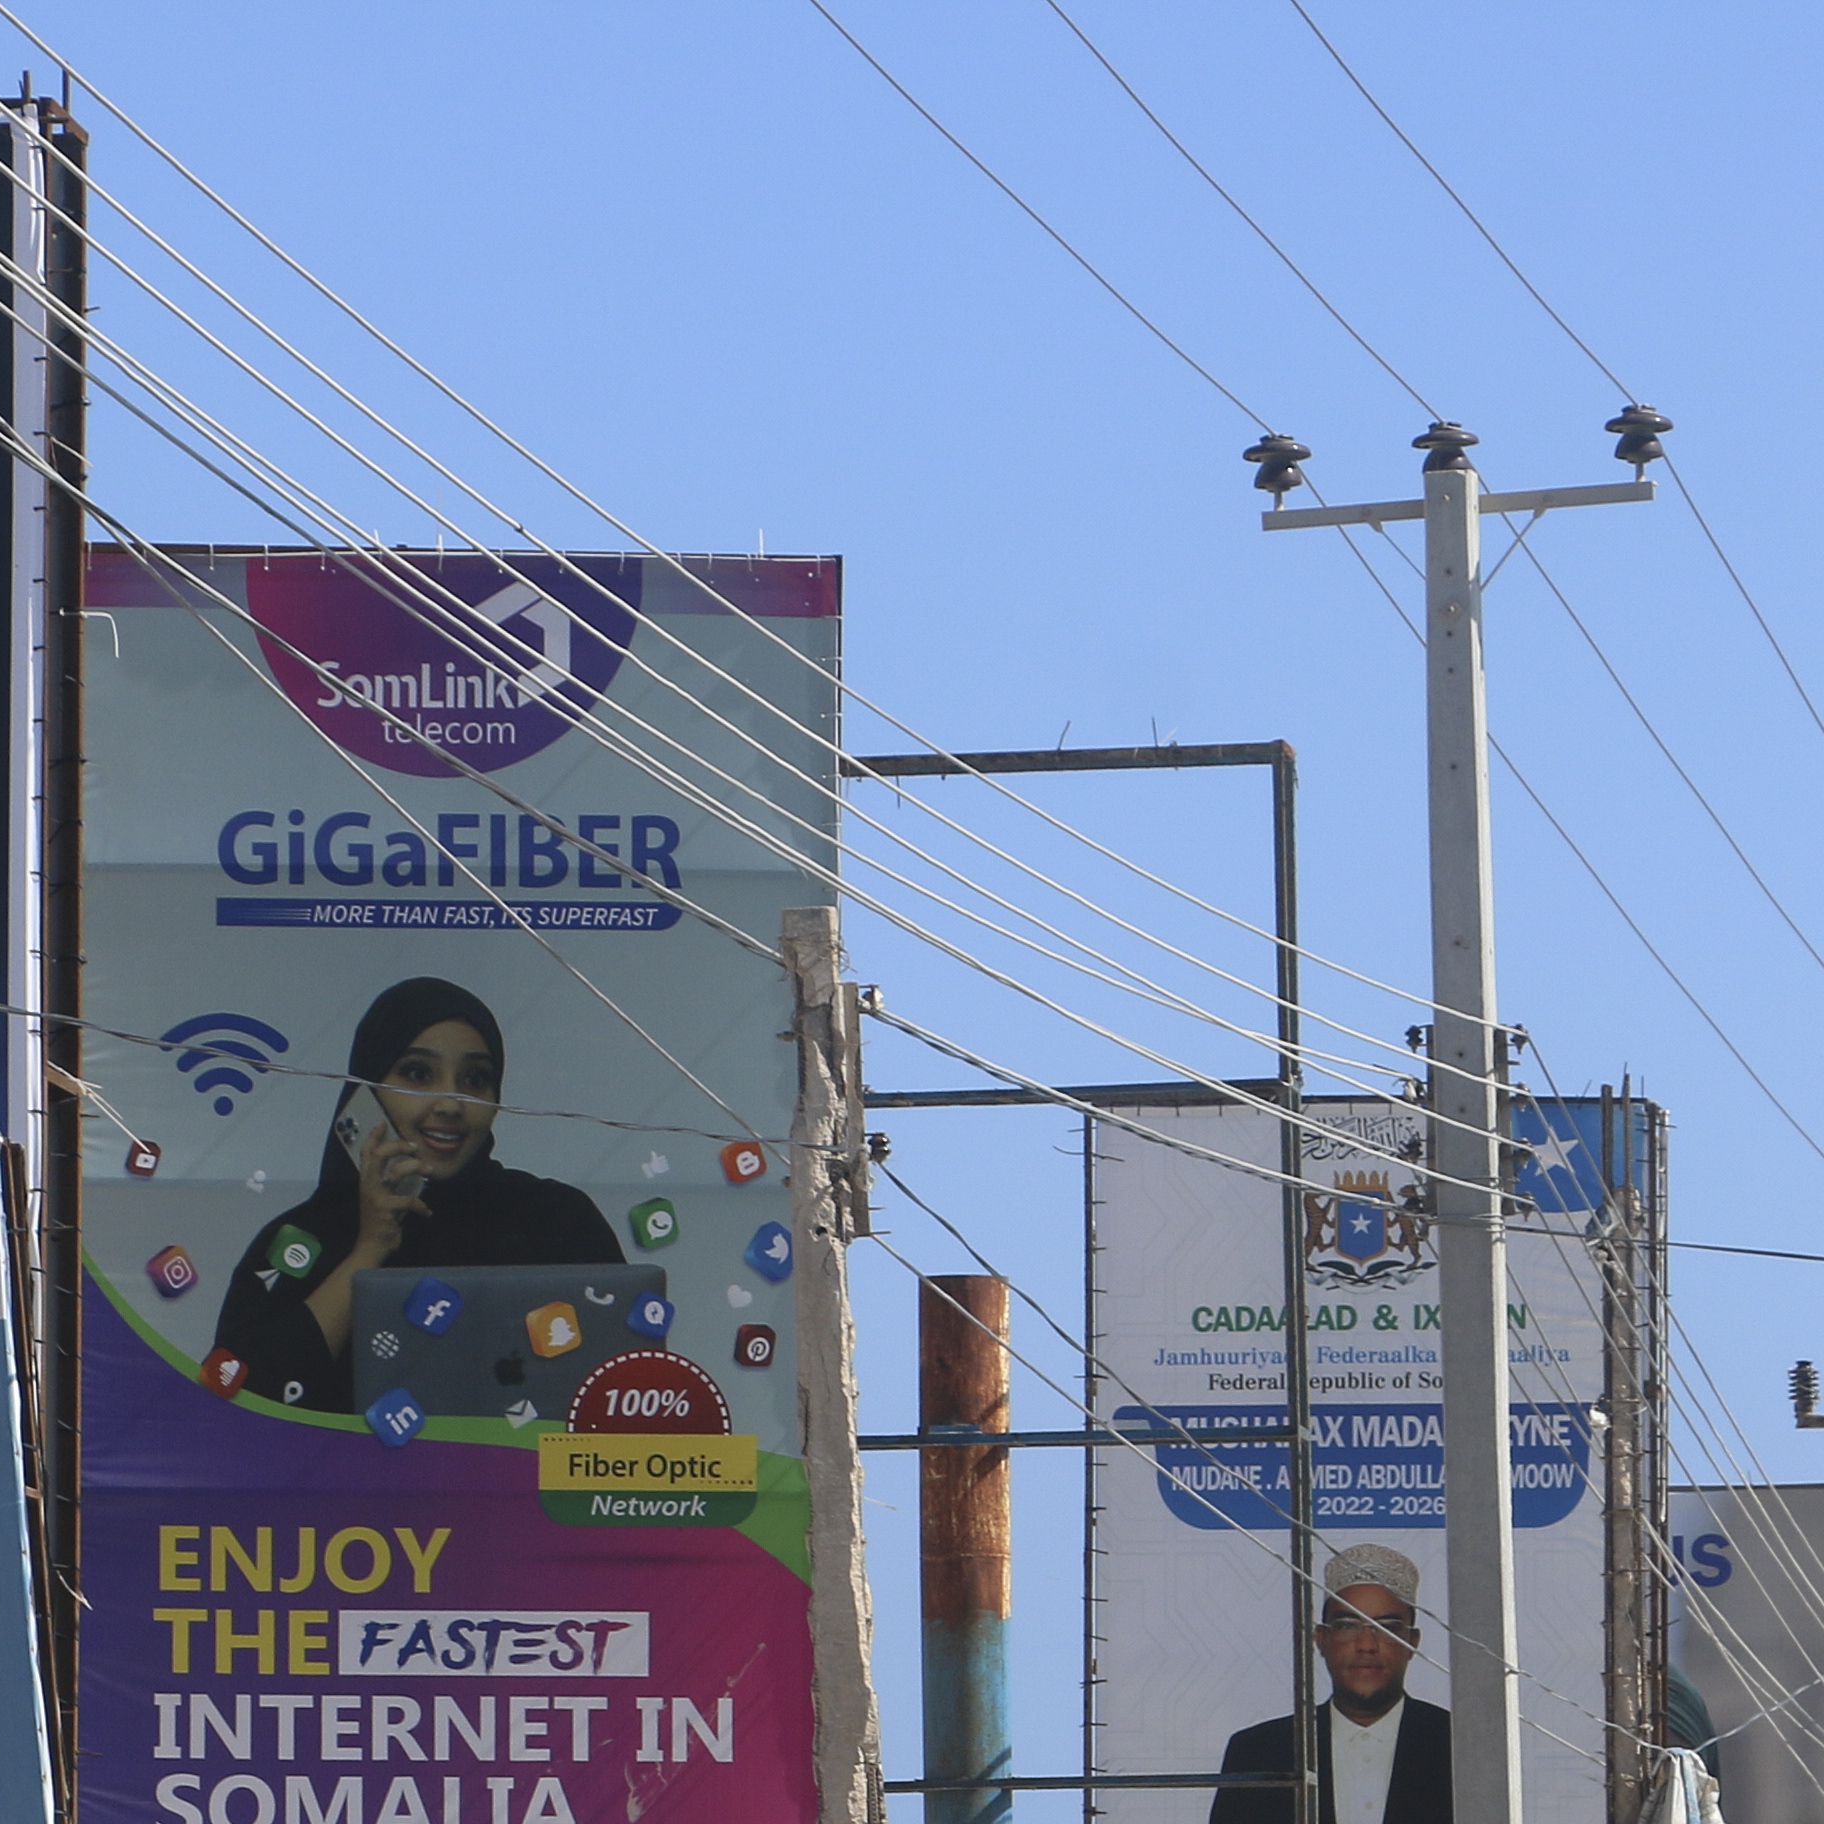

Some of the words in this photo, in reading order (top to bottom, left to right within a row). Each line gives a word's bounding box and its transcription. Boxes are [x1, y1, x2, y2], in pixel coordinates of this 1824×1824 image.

[315, 659, 512, 711] SomLink
[382, 713, 517, 746] telecom
[216, 808, 683, 890] GiGaFIBER
[312, 904, 376, 926] MORE
[380, 905, 438, 926] THAN
[537, 906, 659, 927] SUPERFAST
[1372, 1304, 1399, 1330] &
[1317, 1345, 1438, 1365] Federaalka
[1208, 1373, 1286, 1391] Federal
[1309, 1371, 1386, 1394] epublic
[1391, 1372, 1413, 1390] of
[603, 1388, 690, 1419] 100%
[568, 1452, 639, 1480] Fiber
[646, 1452, 722, 1487] Optic
[590, 1494, 707, 1518] Network
[1317, 1496, 1375, 1516] 2022
[1389, 1496, 1447, 1516] 2026
[157, 1523, 453, 1594] ENJOY
[153, 1607, 331, 1676] THE
[356, 1618, 635, 1675] FASTEST
[153, 1692, 608, 1763] INTERNET
[634, 1696, 734, 1763] IN
